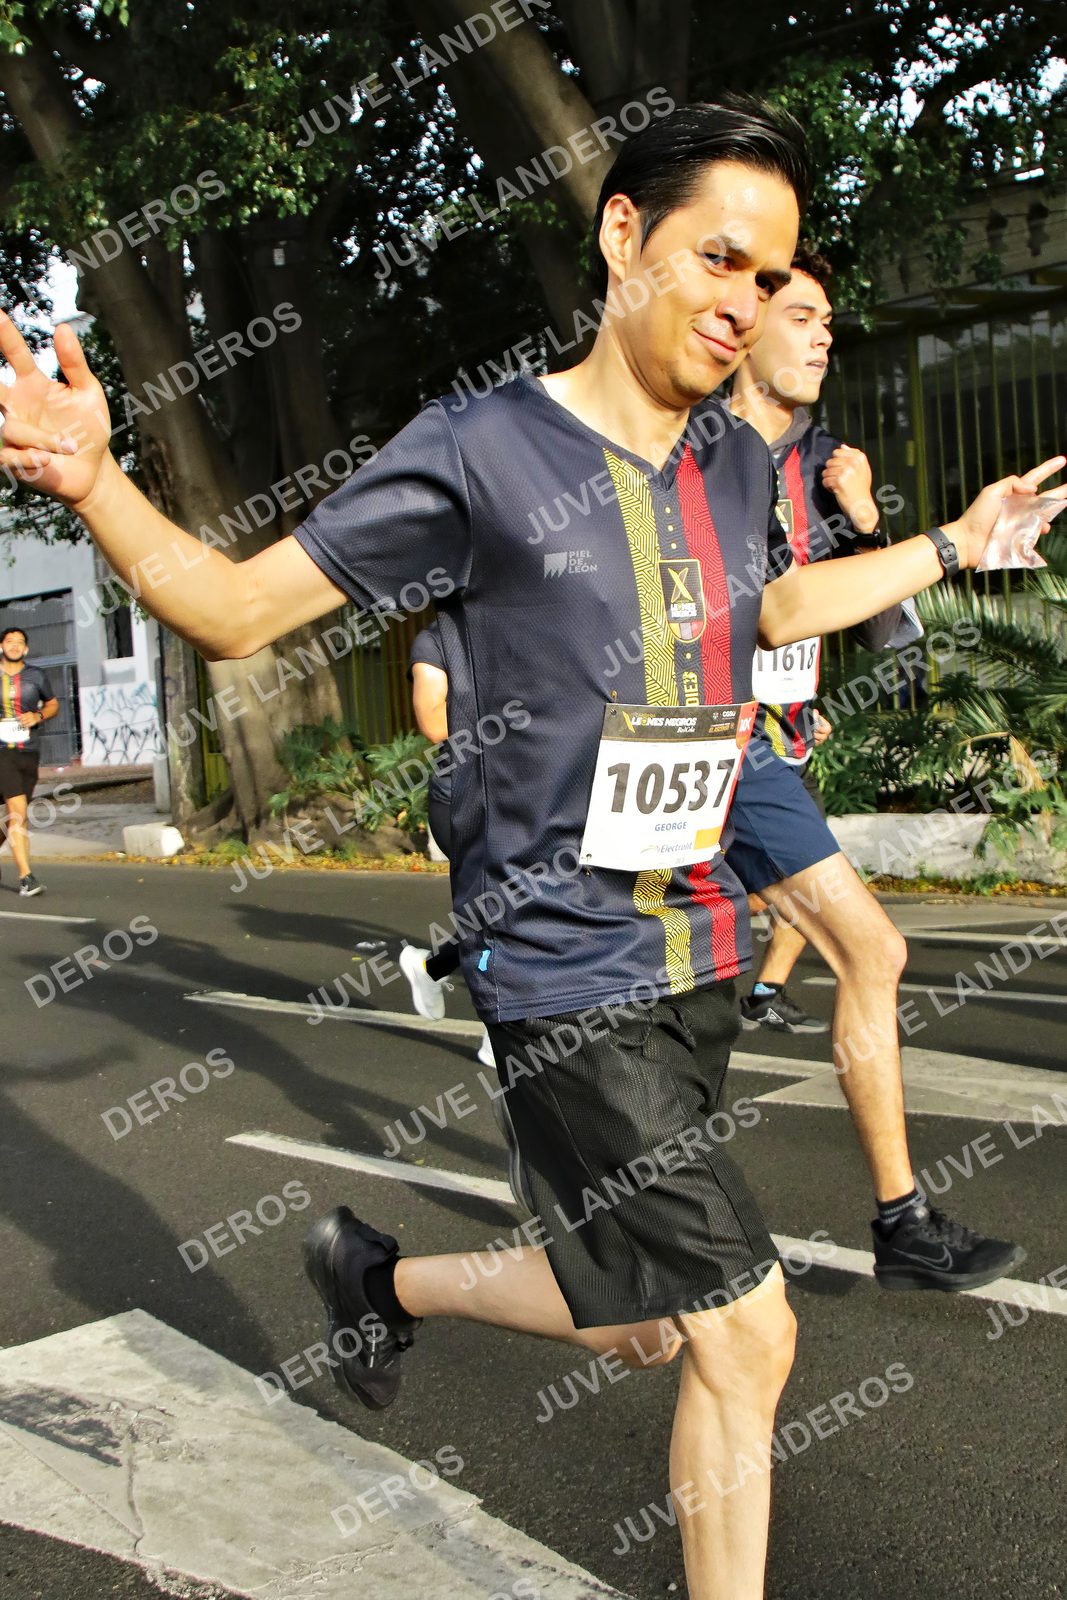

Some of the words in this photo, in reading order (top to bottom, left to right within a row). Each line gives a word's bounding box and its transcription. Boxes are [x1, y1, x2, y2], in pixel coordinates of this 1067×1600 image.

[569, 558, 584, 566] DE
[607, 758, 736, 815] 10537
[654, 821, 688, 832] GEORGE
